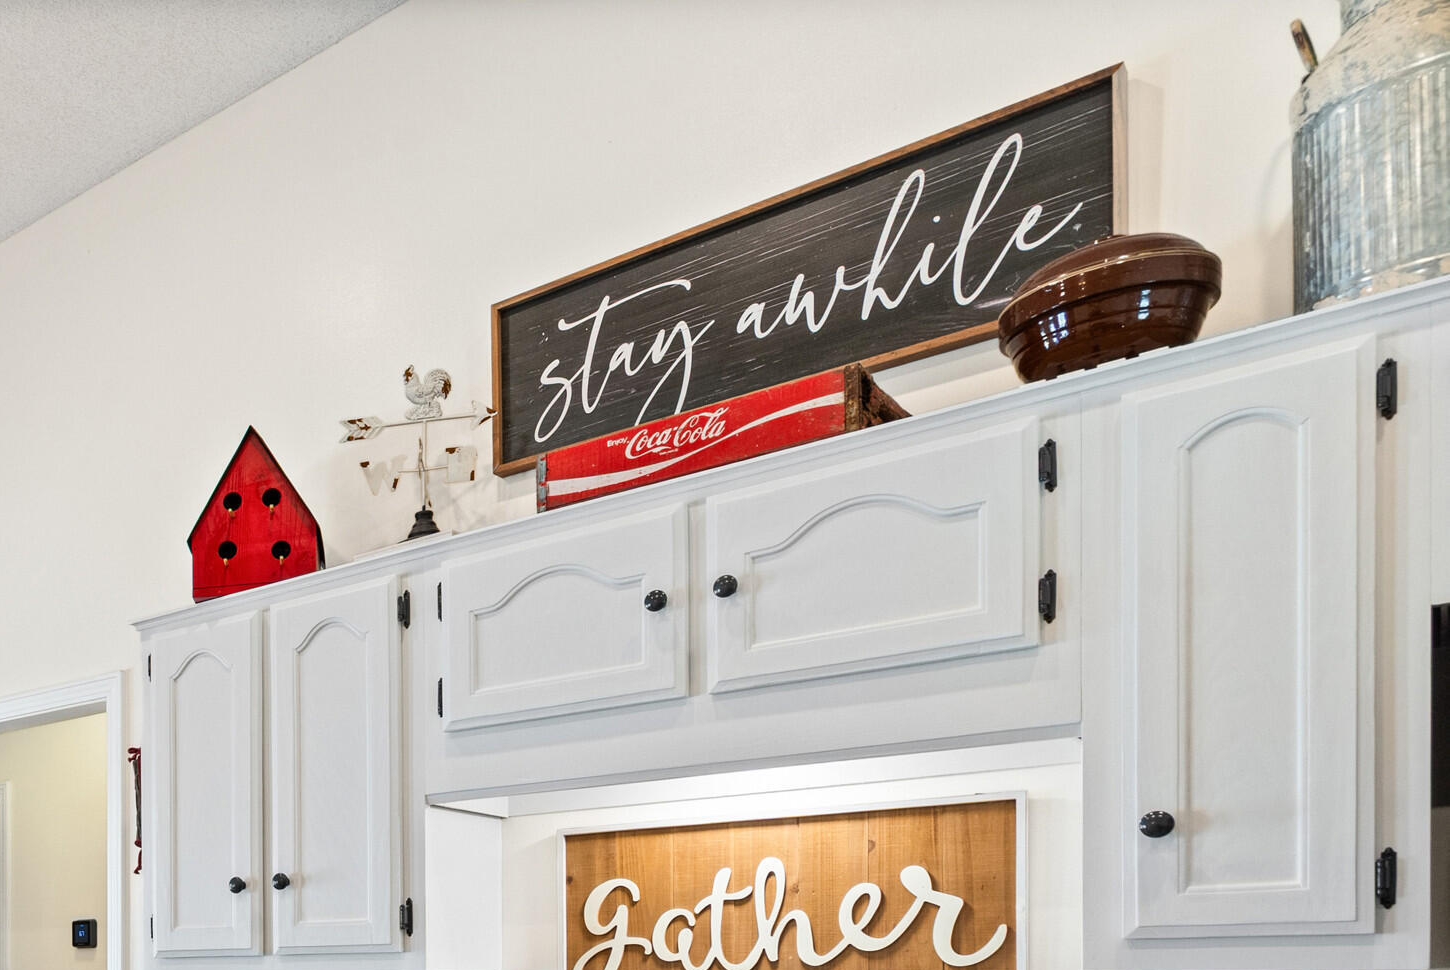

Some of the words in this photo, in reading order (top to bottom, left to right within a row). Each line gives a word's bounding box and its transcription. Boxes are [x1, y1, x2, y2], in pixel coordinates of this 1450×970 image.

[534, 279, 713, 443] stay
[736, 133, 1083, 339] awhile
[625, 407, 729, 460] Coca-Cola
